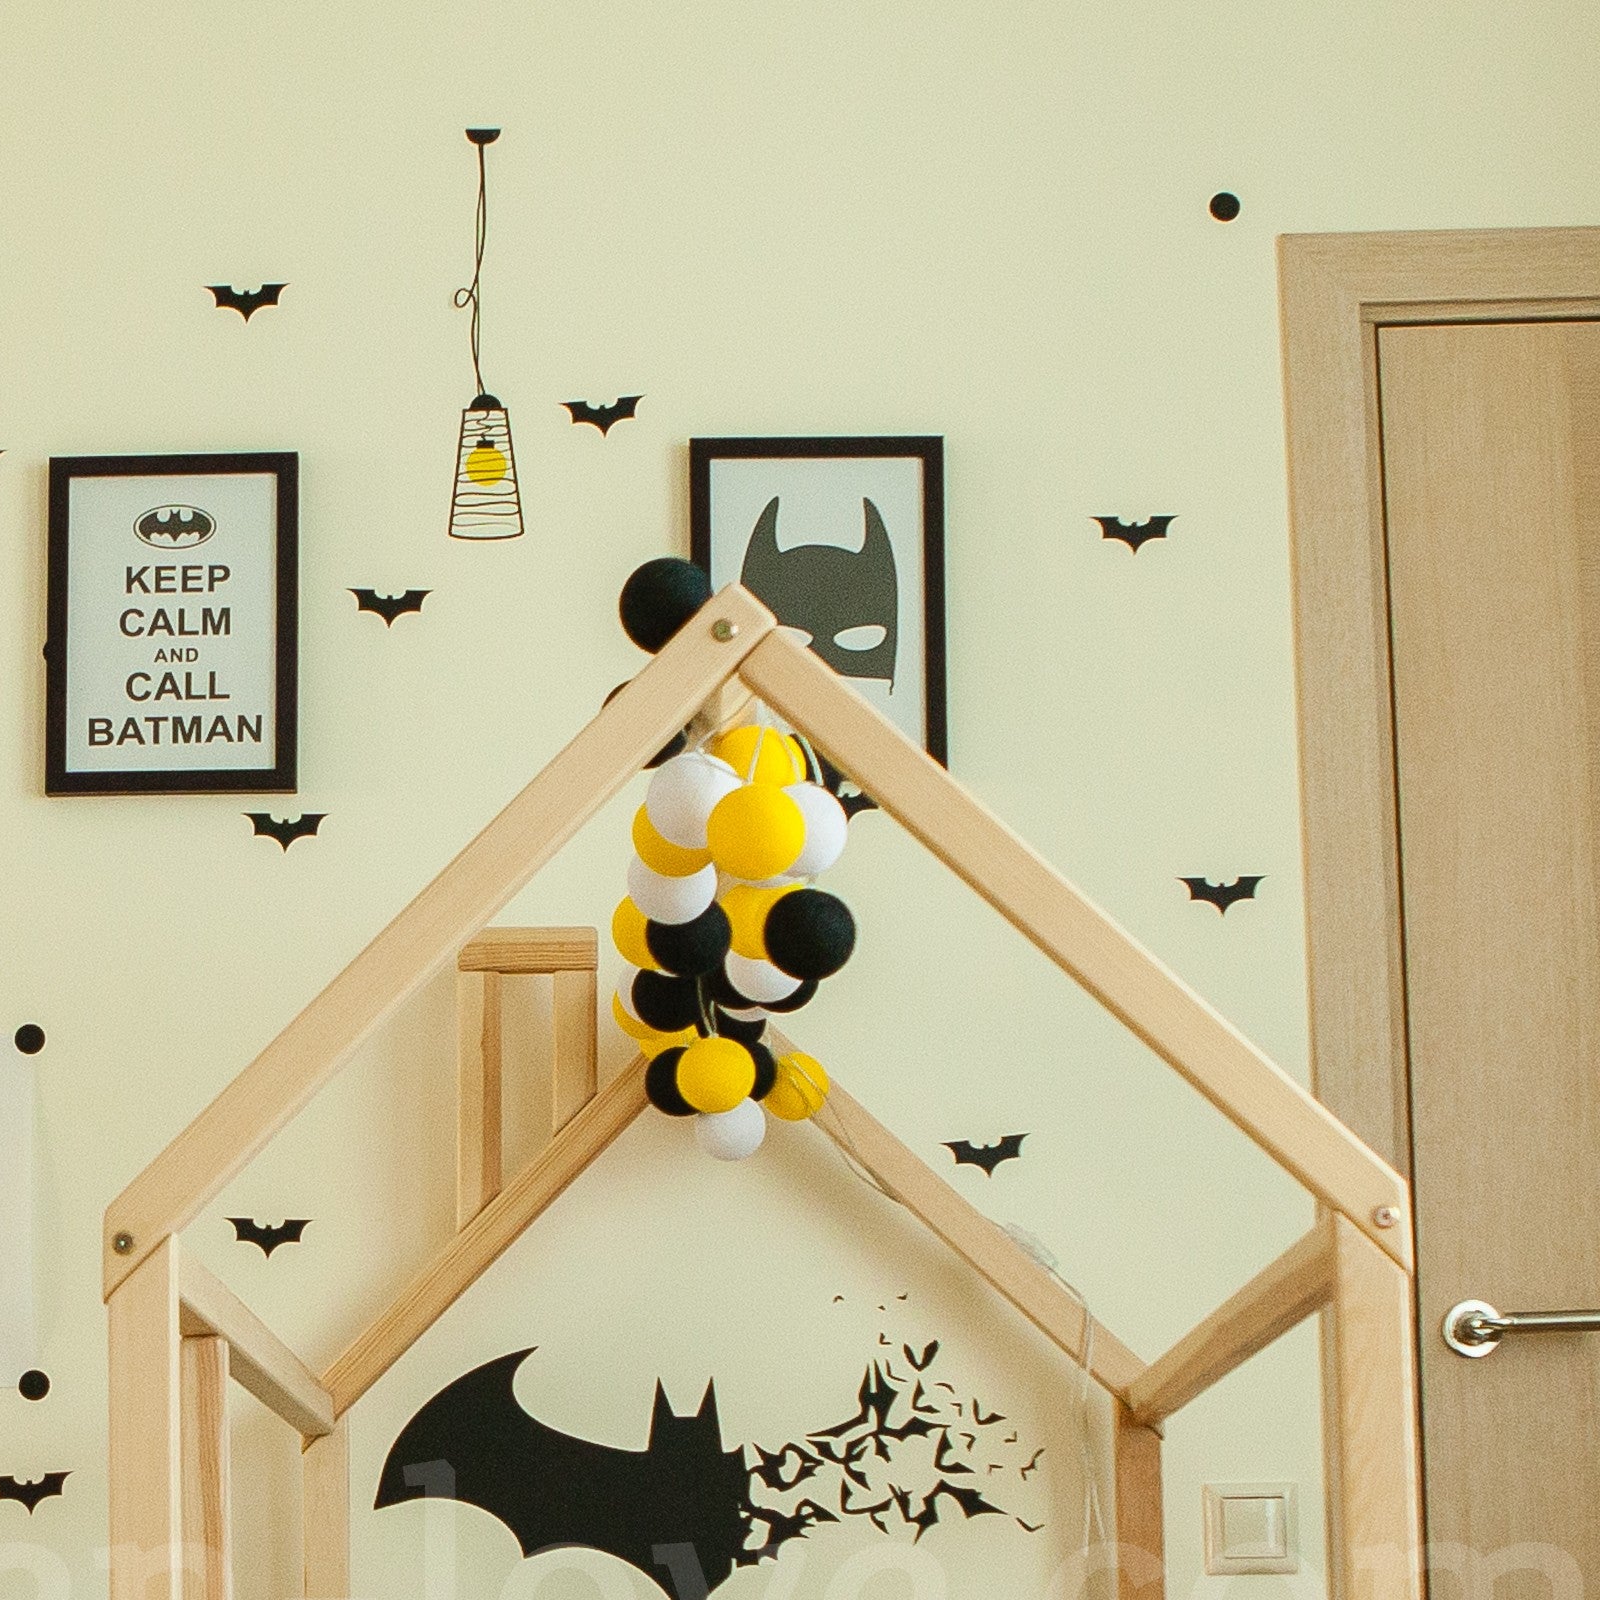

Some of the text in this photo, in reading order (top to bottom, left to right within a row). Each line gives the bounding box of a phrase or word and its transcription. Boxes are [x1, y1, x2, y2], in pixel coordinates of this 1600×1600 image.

[125, 564, 232, 595] KEEP
[119, 607, 232, 638] CALM
[154, 648, 199, 663] AND
[125, 671, 231, 702] CALL
[87, 714, 263, 747] BATMAN
